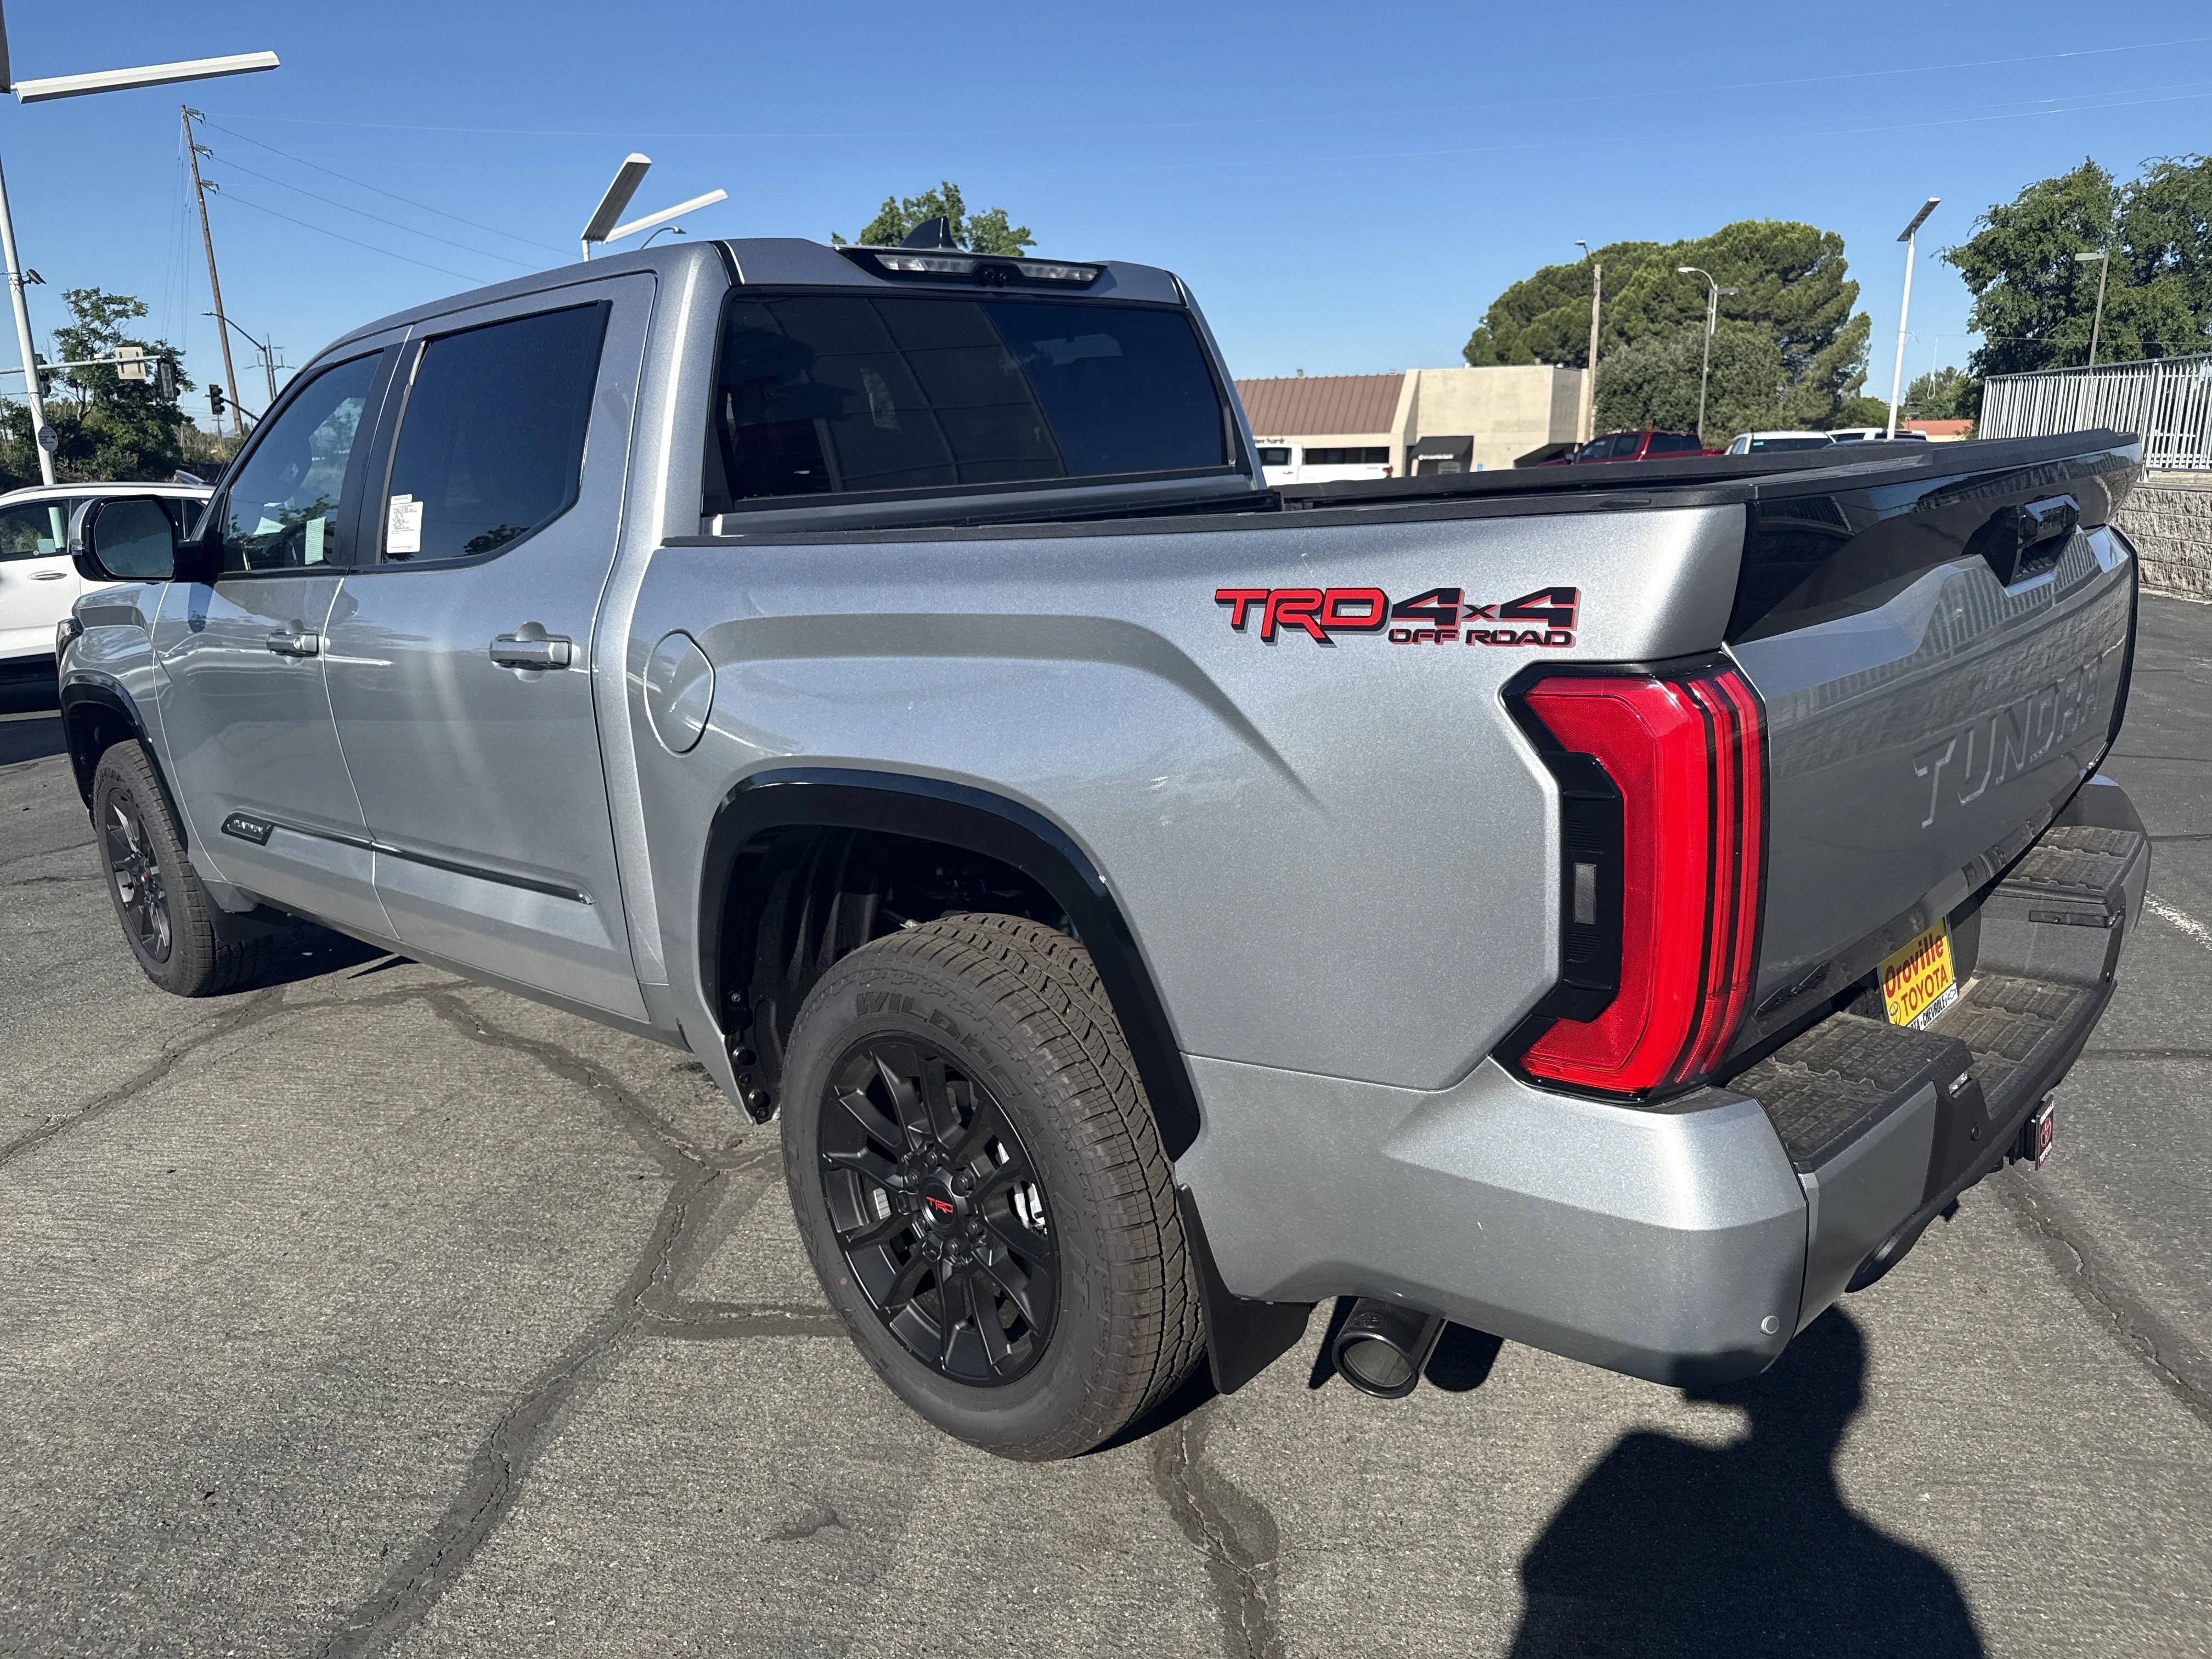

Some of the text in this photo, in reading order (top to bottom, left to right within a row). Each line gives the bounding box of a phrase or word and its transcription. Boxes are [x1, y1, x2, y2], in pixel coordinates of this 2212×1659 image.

[1214, 588, 1390, 648] TRD
[1388, 629, 1575, 647] OFF ROAD
[1912, 651, 2104, 830] TUNDRA
[1885, 933, 1944, 998] Oroville
[1900, 963, 1949, 1017] TOYOTA
[926, 1196, 954, 1214] TRD
